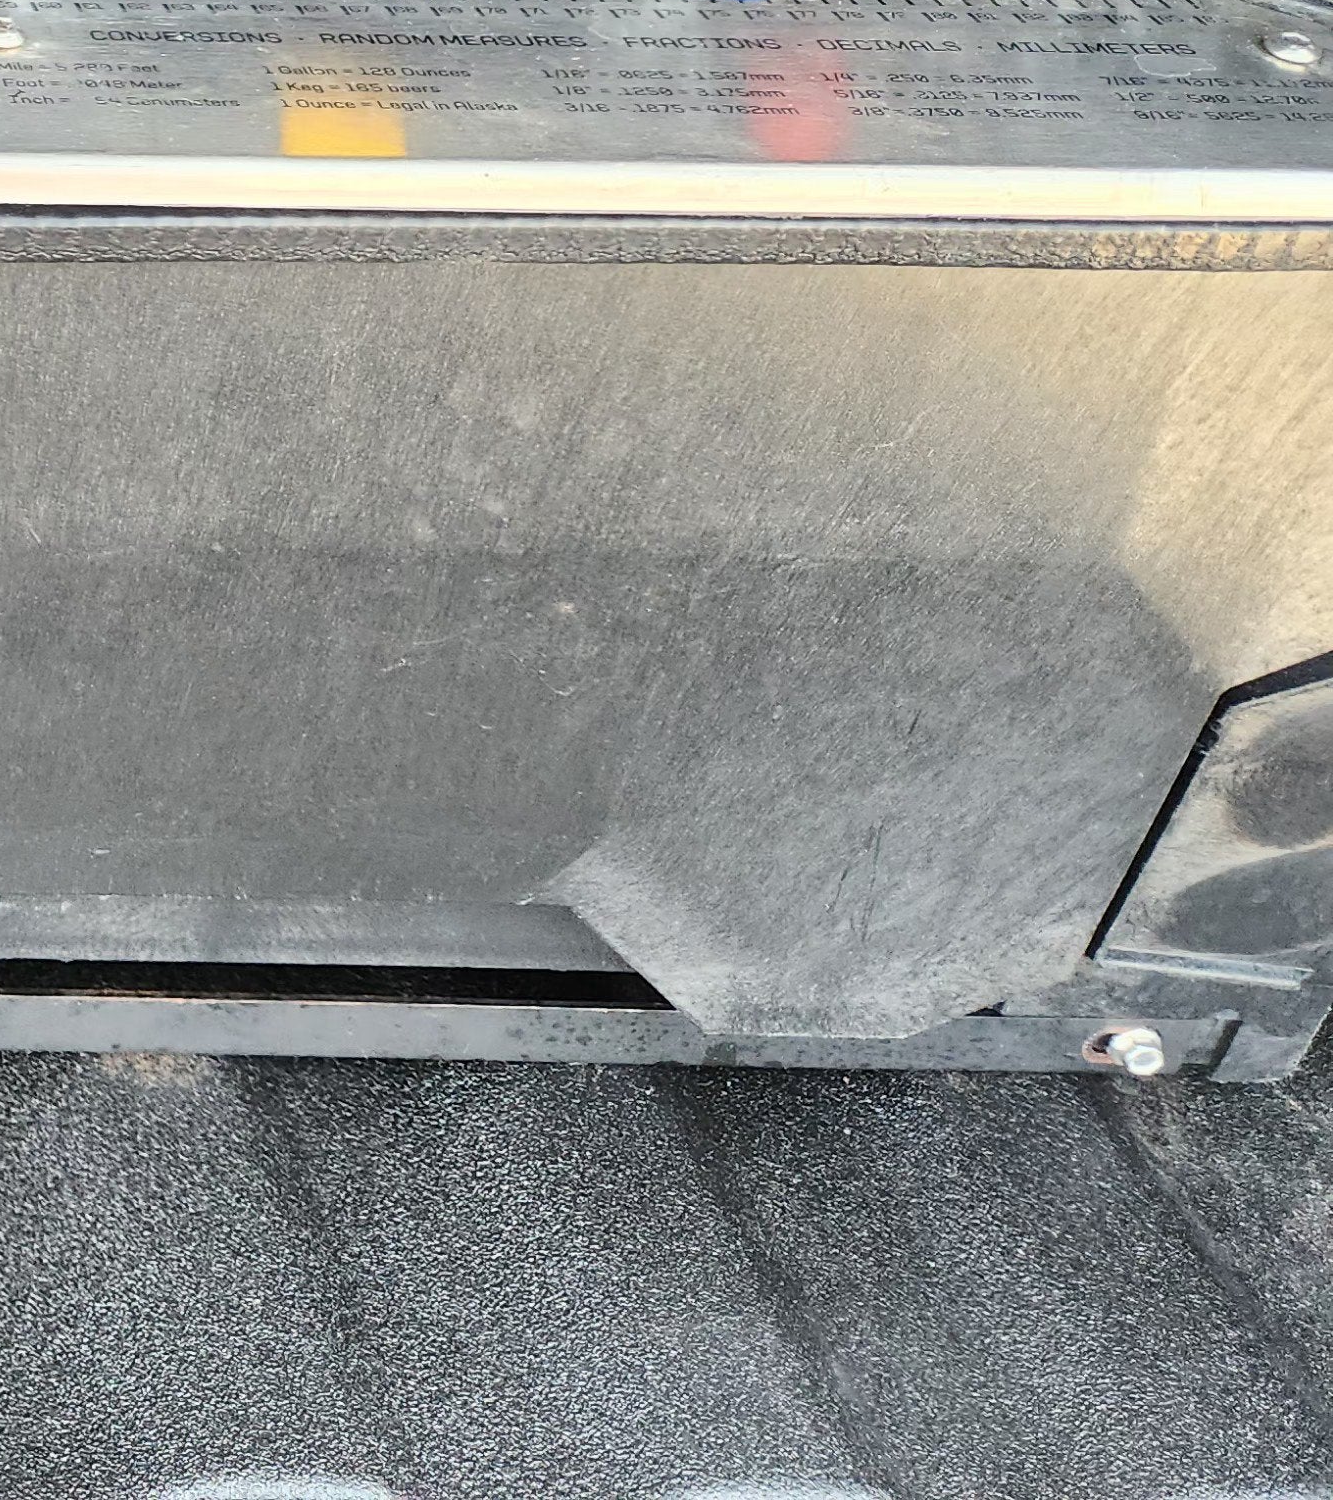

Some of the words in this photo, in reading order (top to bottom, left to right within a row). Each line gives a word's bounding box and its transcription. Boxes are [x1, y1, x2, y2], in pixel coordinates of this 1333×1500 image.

[89, 30, 282, 44] CONVERSIONS
[318, 33, 434, 46] RANDOM
[439, 35, 587, 48] MEASURES
[622, 37, 782, 50] FRACTIONS
[816, 39, 963, 52] DECIMALS
[995, 42, 1197, 56] MILLIMETERS
[262, 66, 273, 74] 1
[278, 66, 337, 76] Gallon
[359, 66, 397, 76] 128
[401, 67, 471, 78] Ounces
[693, 71, 785, 82] 1.587mm
[1, 78, 45, 88] Foot
[129, 80, 183, 88] Meter
[885, 73, 930, 83] .250
[950, 74, 1033, 84] 6.35mm
[270, 82, 283, 90] 1
[286, 82, 325, 93] Keg
[345, 82, 383, 92] 165
[387, 83, 442, 94] beers
[617, 86, 674, 97] .1250
[697, 88, 786, 98] 3.175mm
[8, 94, 55, 104] Inch
[279, 98, 292, 108] 1
[295, 99, 357, 109] Ounce
[377, 100, 431, 112] Legal
[433, 100, 451, 111] in
[454, 100, 519, 112] Alaska
[633, 103, 685, 114] .1875
[706, 104, 800, 115] 4.762mm
[908, 108, 965, 117] .3750
